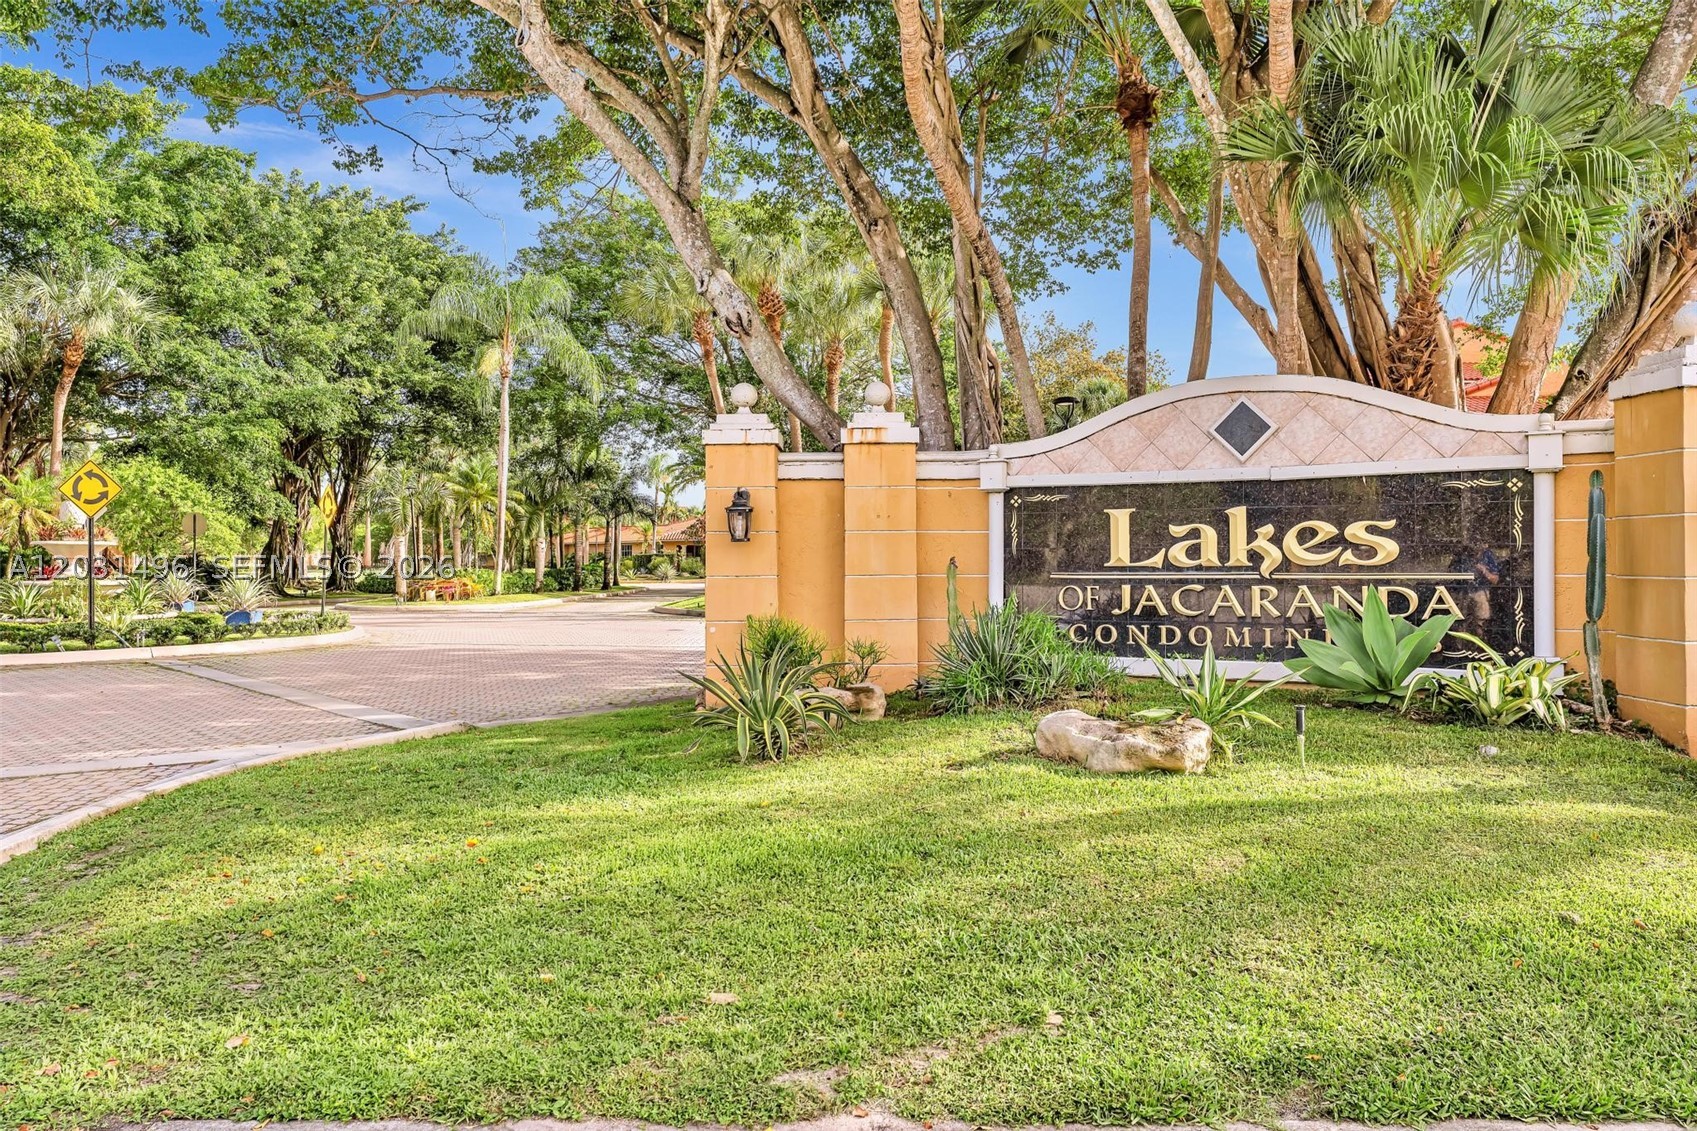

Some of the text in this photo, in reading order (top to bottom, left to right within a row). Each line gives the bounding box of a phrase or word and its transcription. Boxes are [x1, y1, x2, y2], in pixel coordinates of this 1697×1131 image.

[1103, 505, 1400, 580] Lakes
[1058, 584, 1465, 620] OF JACARANDA
